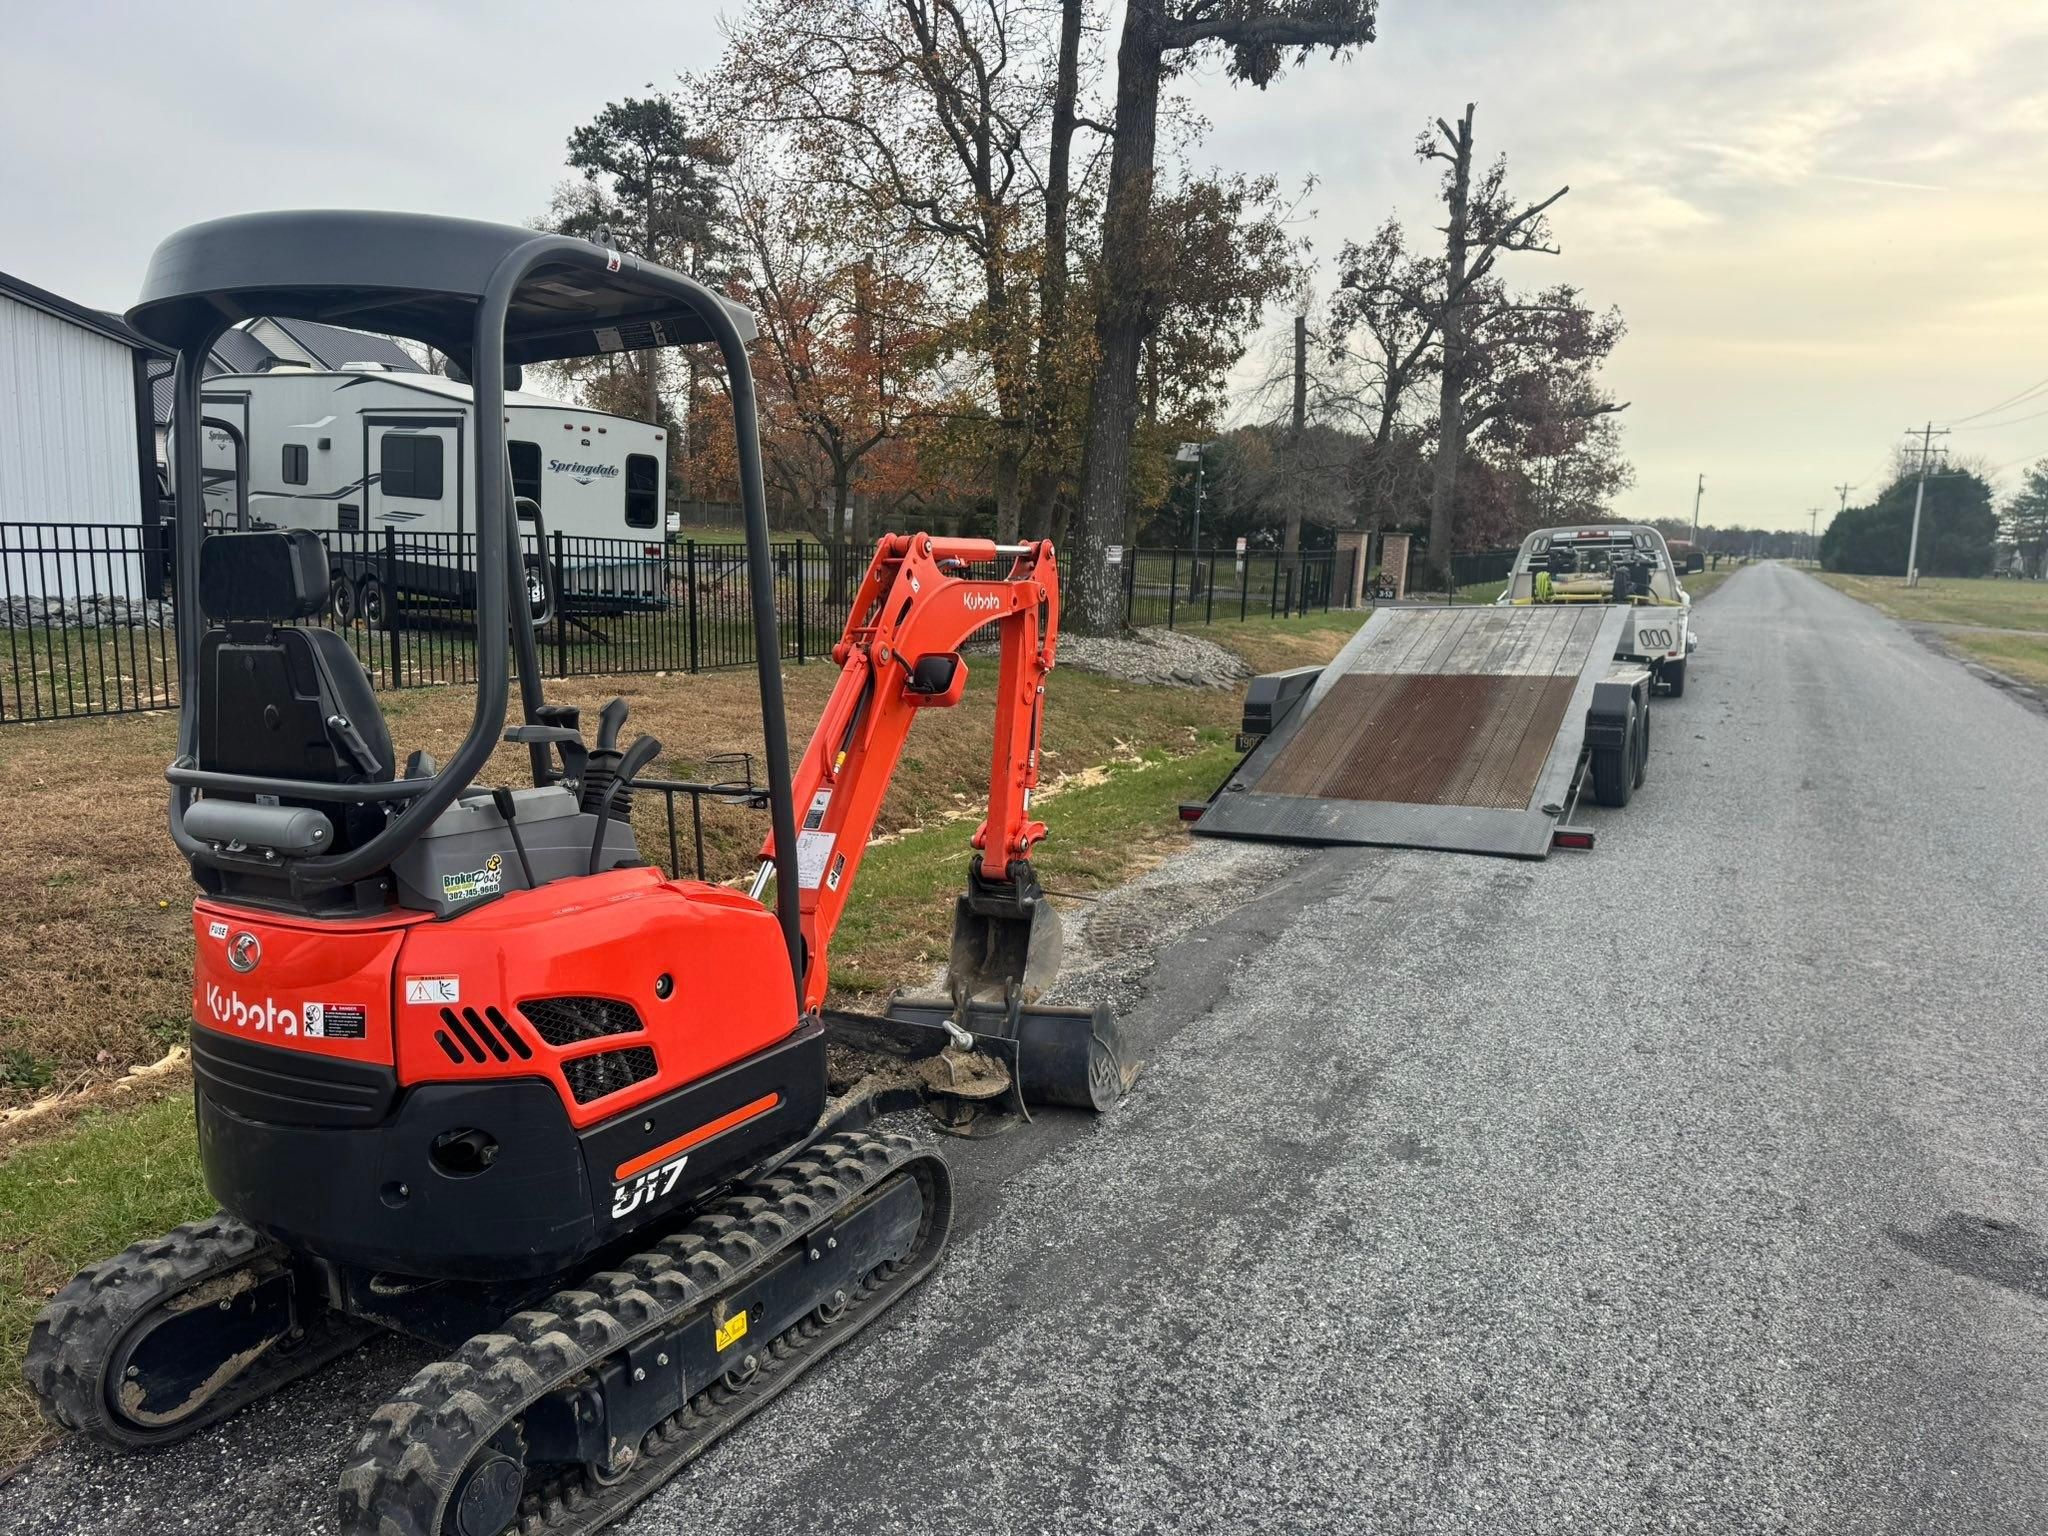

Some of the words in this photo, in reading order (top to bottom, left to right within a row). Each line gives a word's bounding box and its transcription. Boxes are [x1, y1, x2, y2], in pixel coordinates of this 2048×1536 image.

[547, 459, 619, 477] Springdale
[963, 591, 1000, 610] Kubota
[211, 925, 227, 937] FUSE
[206, 981, 298, 1036] Kubota
